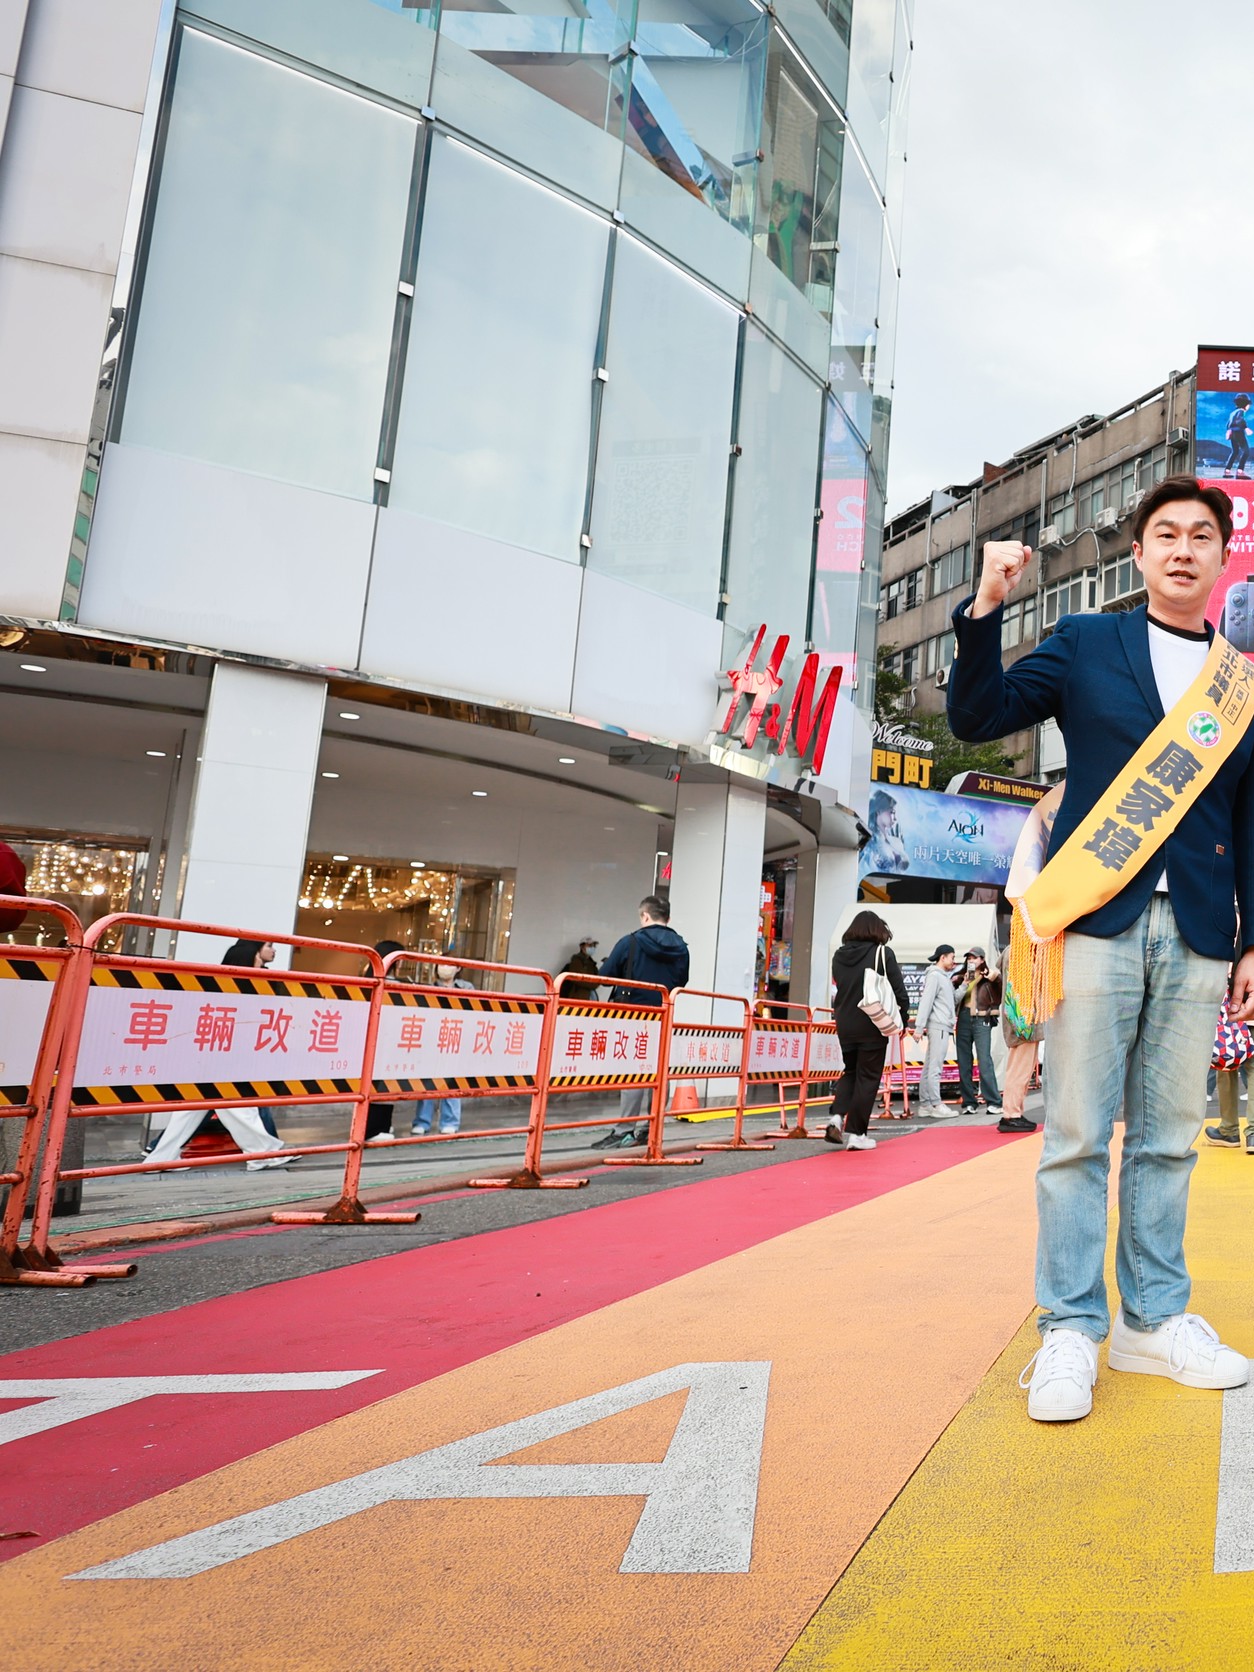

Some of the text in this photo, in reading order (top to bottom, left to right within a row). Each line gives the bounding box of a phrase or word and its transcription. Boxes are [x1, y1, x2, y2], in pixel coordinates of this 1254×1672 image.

[722, 623, 843, 776] H&M
[871, 722, 934, 752] Welcome
[978, 777, 1045, 801] Xi-Men Walker
[1082, 741, 1204, 872] 康家瑋
[124, 999, 342, 1053] 車輛改道
[397, 1014, 526, 1056] 車輛改道
[565, 1028, 650, 1061] 車輛改道
[686, 1041, 730, 1063] 車輛改道
[755, 1036, 800, 1059] 車輛改道
[103, 1064, 157, 1077] 北市警局
[330, 1060, 349, 1071] 109
